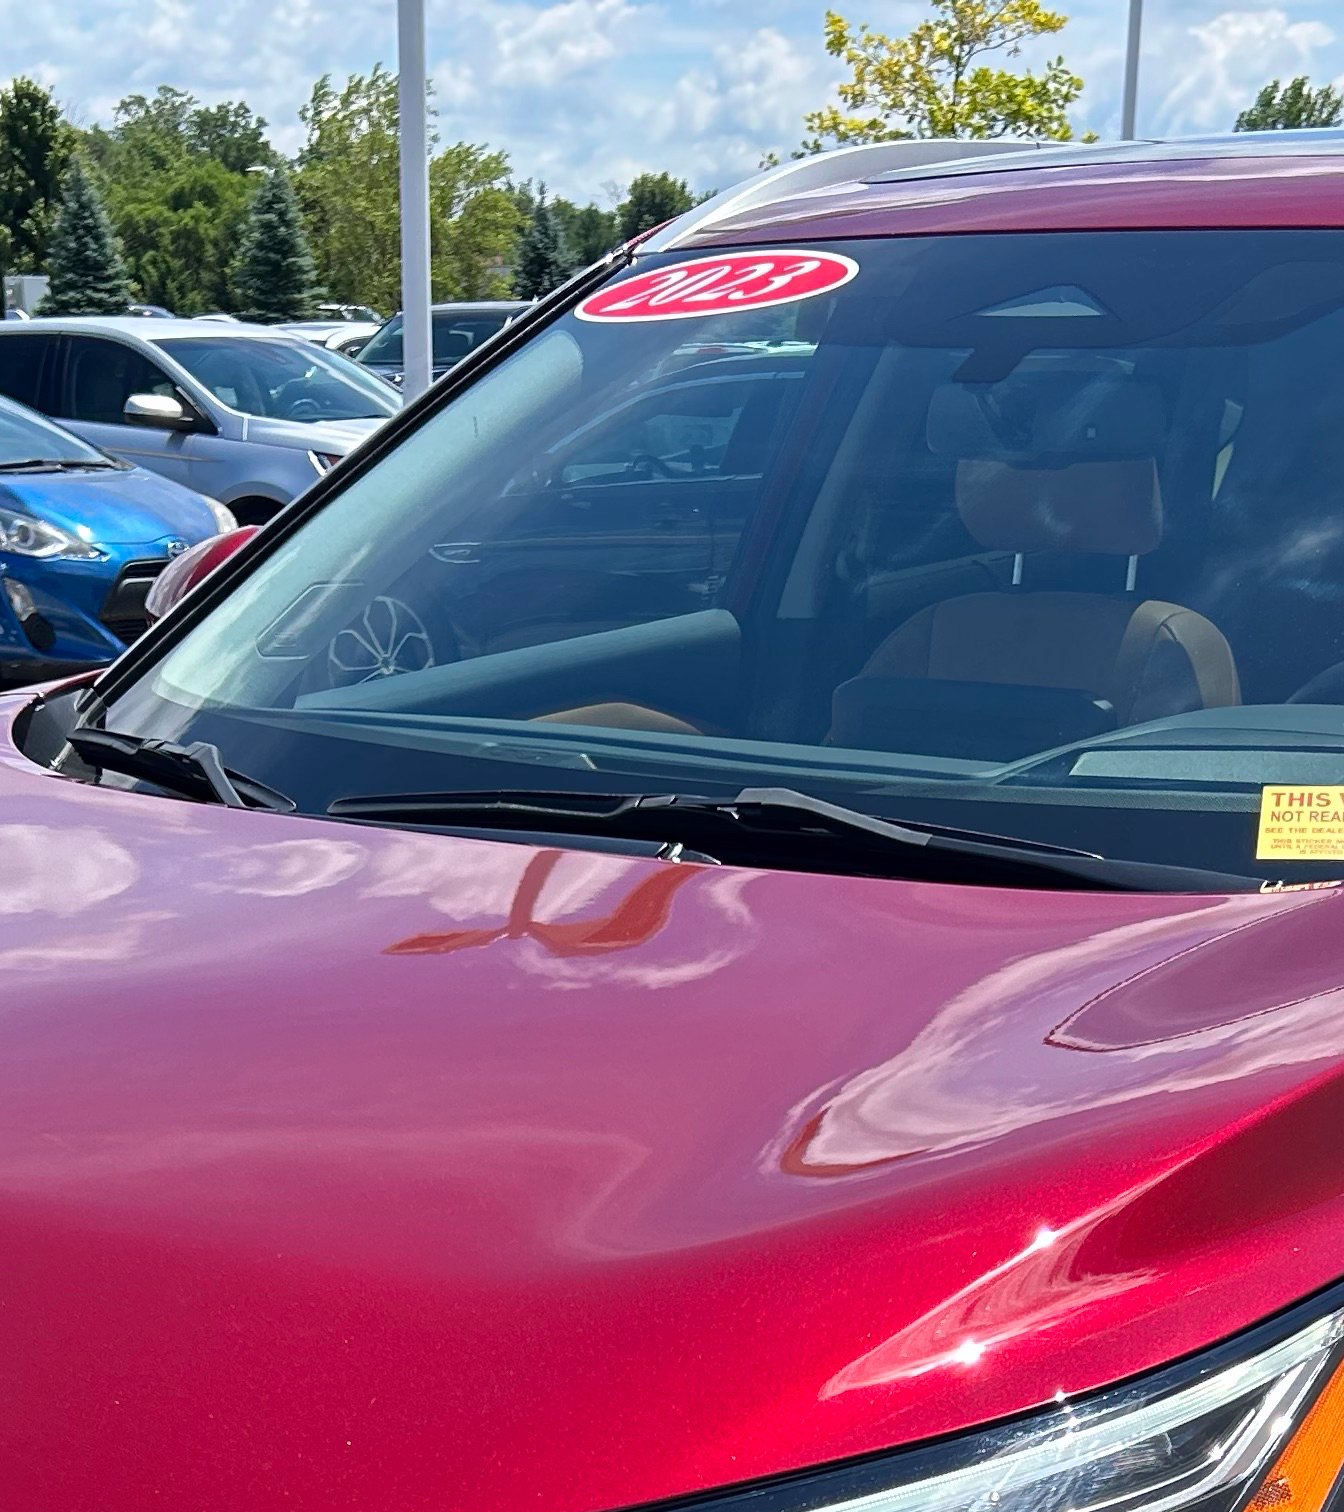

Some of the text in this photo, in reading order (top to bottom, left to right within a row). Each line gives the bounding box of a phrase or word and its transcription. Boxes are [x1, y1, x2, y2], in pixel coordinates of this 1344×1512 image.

[599, 260, 821, 313] 2023
[1271, 792, 1331, 808] THIS
[1270, 811, 1304, 823] NOT
